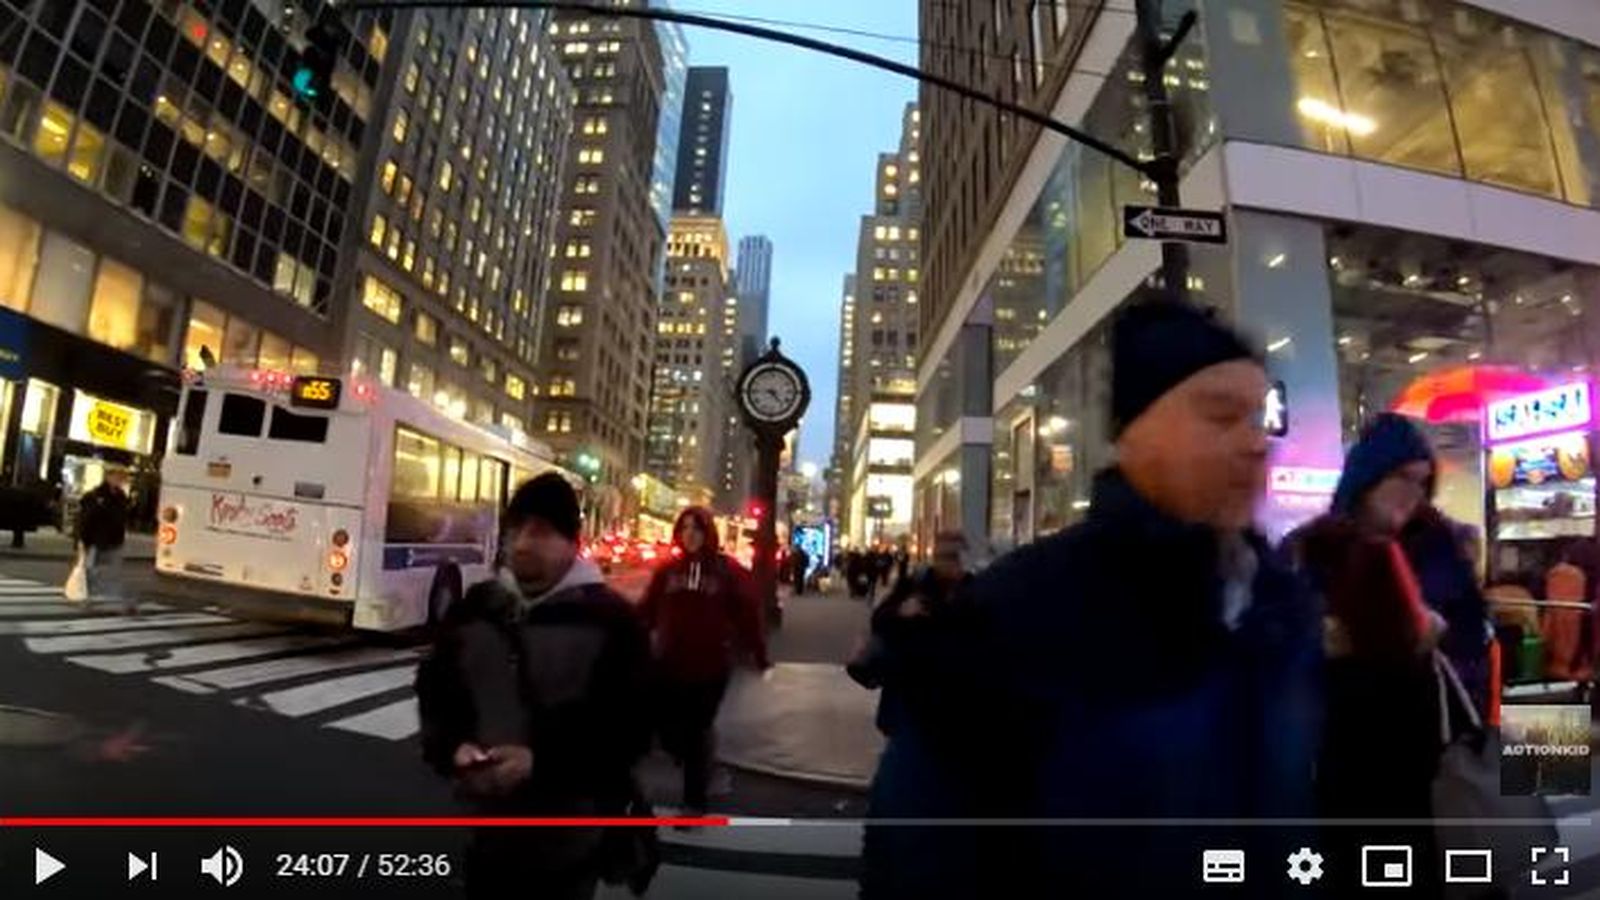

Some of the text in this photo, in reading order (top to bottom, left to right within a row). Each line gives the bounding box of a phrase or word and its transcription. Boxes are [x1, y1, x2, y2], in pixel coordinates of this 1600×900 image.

[1140, 214, 1214, 232] ONE WAY
[97, 409, 128, 427] BEST
[96, 422, 123, 440] BUY
